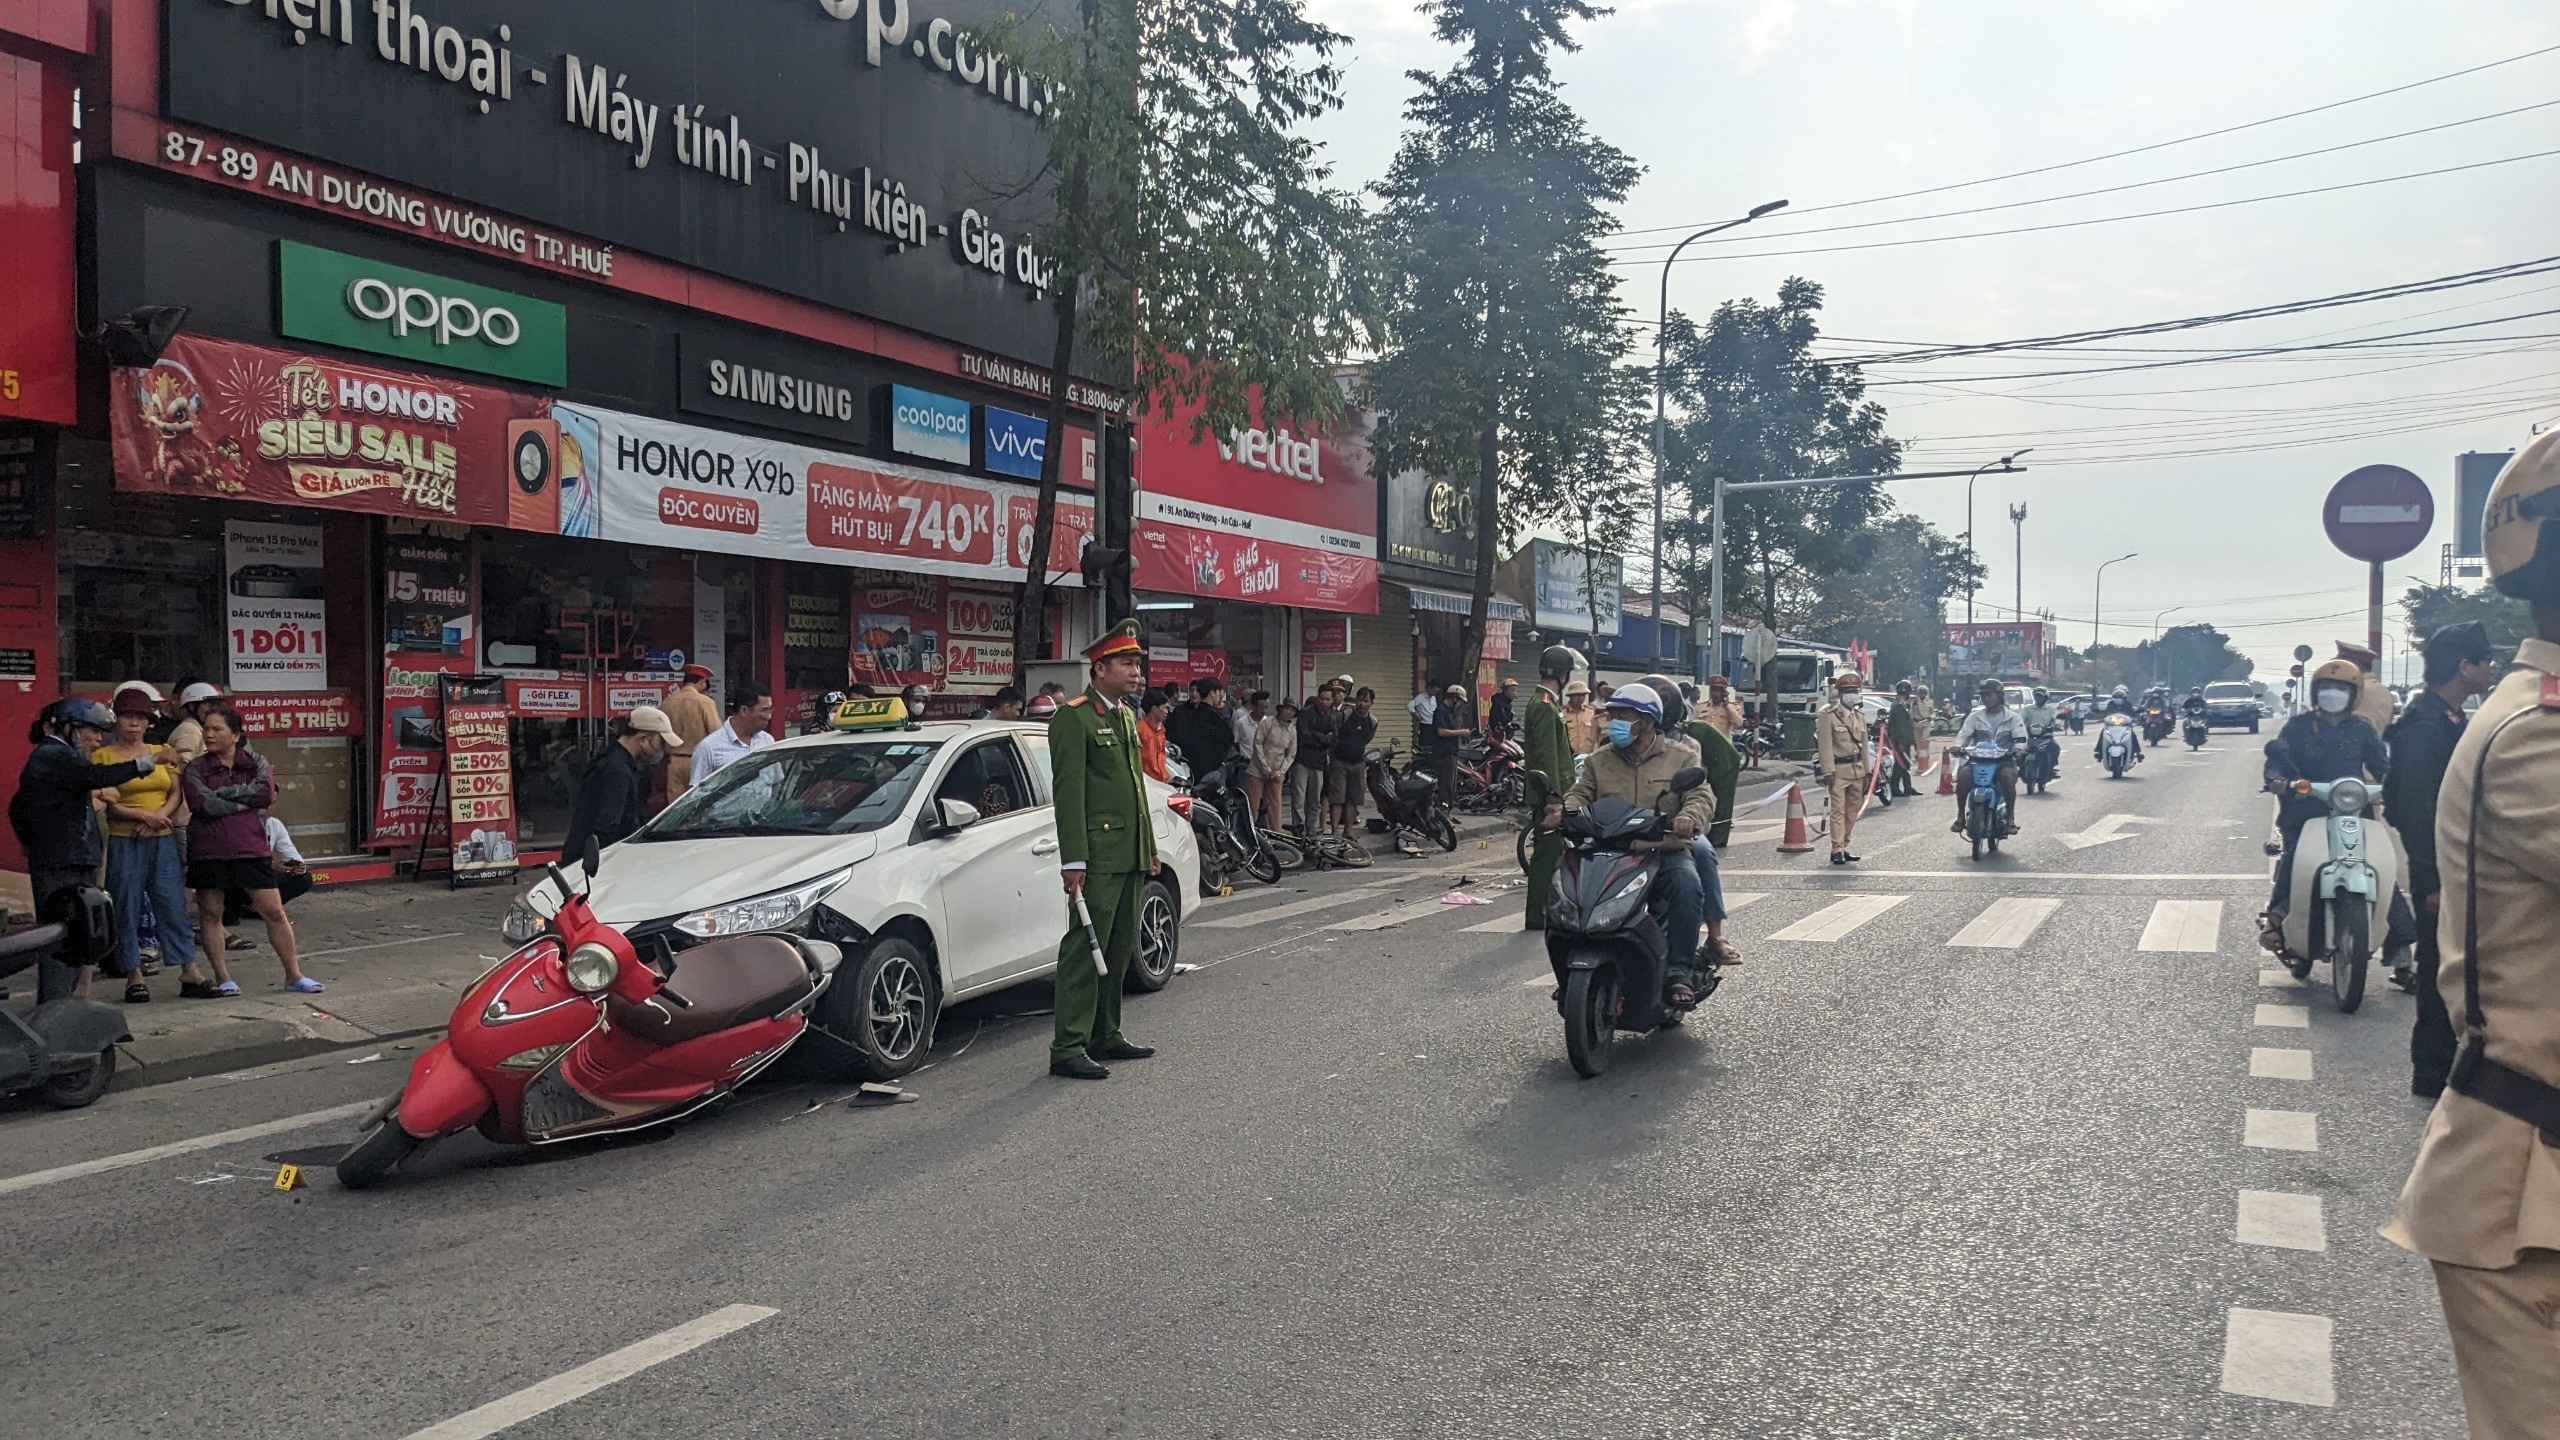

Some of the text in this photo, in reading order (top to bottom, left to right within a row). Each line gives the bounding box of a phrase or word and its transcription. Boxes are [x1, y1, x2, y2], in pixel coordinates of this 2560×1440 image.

[373, 0, 512, 114] thoại
[566, 53, 659, 169] Máy
[673, 104, 751, 186] tính
[789, 141, 851, 233] Phụ
[864, 166, 927, 254] kiện
[960, 208, 1006, 275] Gia
[166, 131, 613, 277] 87-89 AN DƯƠNG VƯƠNG TP.HUẾ
[347, 277, 520, 347] oppo
[962, 353, 983, 376] TƯ
[985, 356, 1010, 385] VẤN
[1013, 366, 1039, 393] BÁN
[281, 364, 458, 426] Tết HONOR
[710, 359, 852, 421] SAMSUNG
[898, 404, 967, 435] coolpad
[257, 409, 457, 479] SIÊU SALE
[617, 435, 795, 496] HONOR X9b
[300, 471, 391, 493] GIÁ LUÔN RẺ
[401, 466, 457, 514] Hết
[810, 479, 892, 514] TẶNG MÁY
[662, 494, 756, 526] ĐỘC QUYỀN
[1013, 503, 1032, 521] TRẢ
[1167, 505, 1175, 515] 91
[831, 511, 893, 546] HÚT BỤI
[897, 495, 990, 553] 740K
[1069, 511, 1087, 529] TRẢ
[230, 532, 319, 548] iPhone 15 Pro Max
[1143, 531, 1166, 543] viettel
[388, 571, 467, 608] 15 TRIỆU
[232, 608, 322, 620] ĐẶC QUYỀN 12 THÁNG
[232, 622, 323, 654] 1 ĐỔI 1
[948, 645, 977, 676] 24
[977, 647, 989, 656] TRẢ
[235, 662, 252, 670] THU
[254, 660, 271, 670] MÁY
[977, 659, 1013, 677] THÁNG
[448, 686, 469, 694] FPT
[531, 690, 570, 700] Gói FLEX
[282, 699, 306, 707] APPLE
[844, 700, 889, 715] TAXI
[266, 707, 350, 731] 1.5 TRIỆU
[464, 711, 480, 720] GIA
[481, 711, 505, 721] DỤNG
[448, 721, 507, 738] SIÊU SALE
[453, 753, 468, 762] GIẢM
[470, 753, 506, 769] 50%
[457, 775, 471, 785] TRẢ
[472, 776, 504, 794] 0%
[396, 776, 435, 805] 3%
[456, 786, 471, 794] GÓP
[459, 800, 472, 811] CHỈ
[473, 800, 504, 819] 9K
[461, 811, 472, 820] TỪ
[281, 1169, 291, 1186] 9
